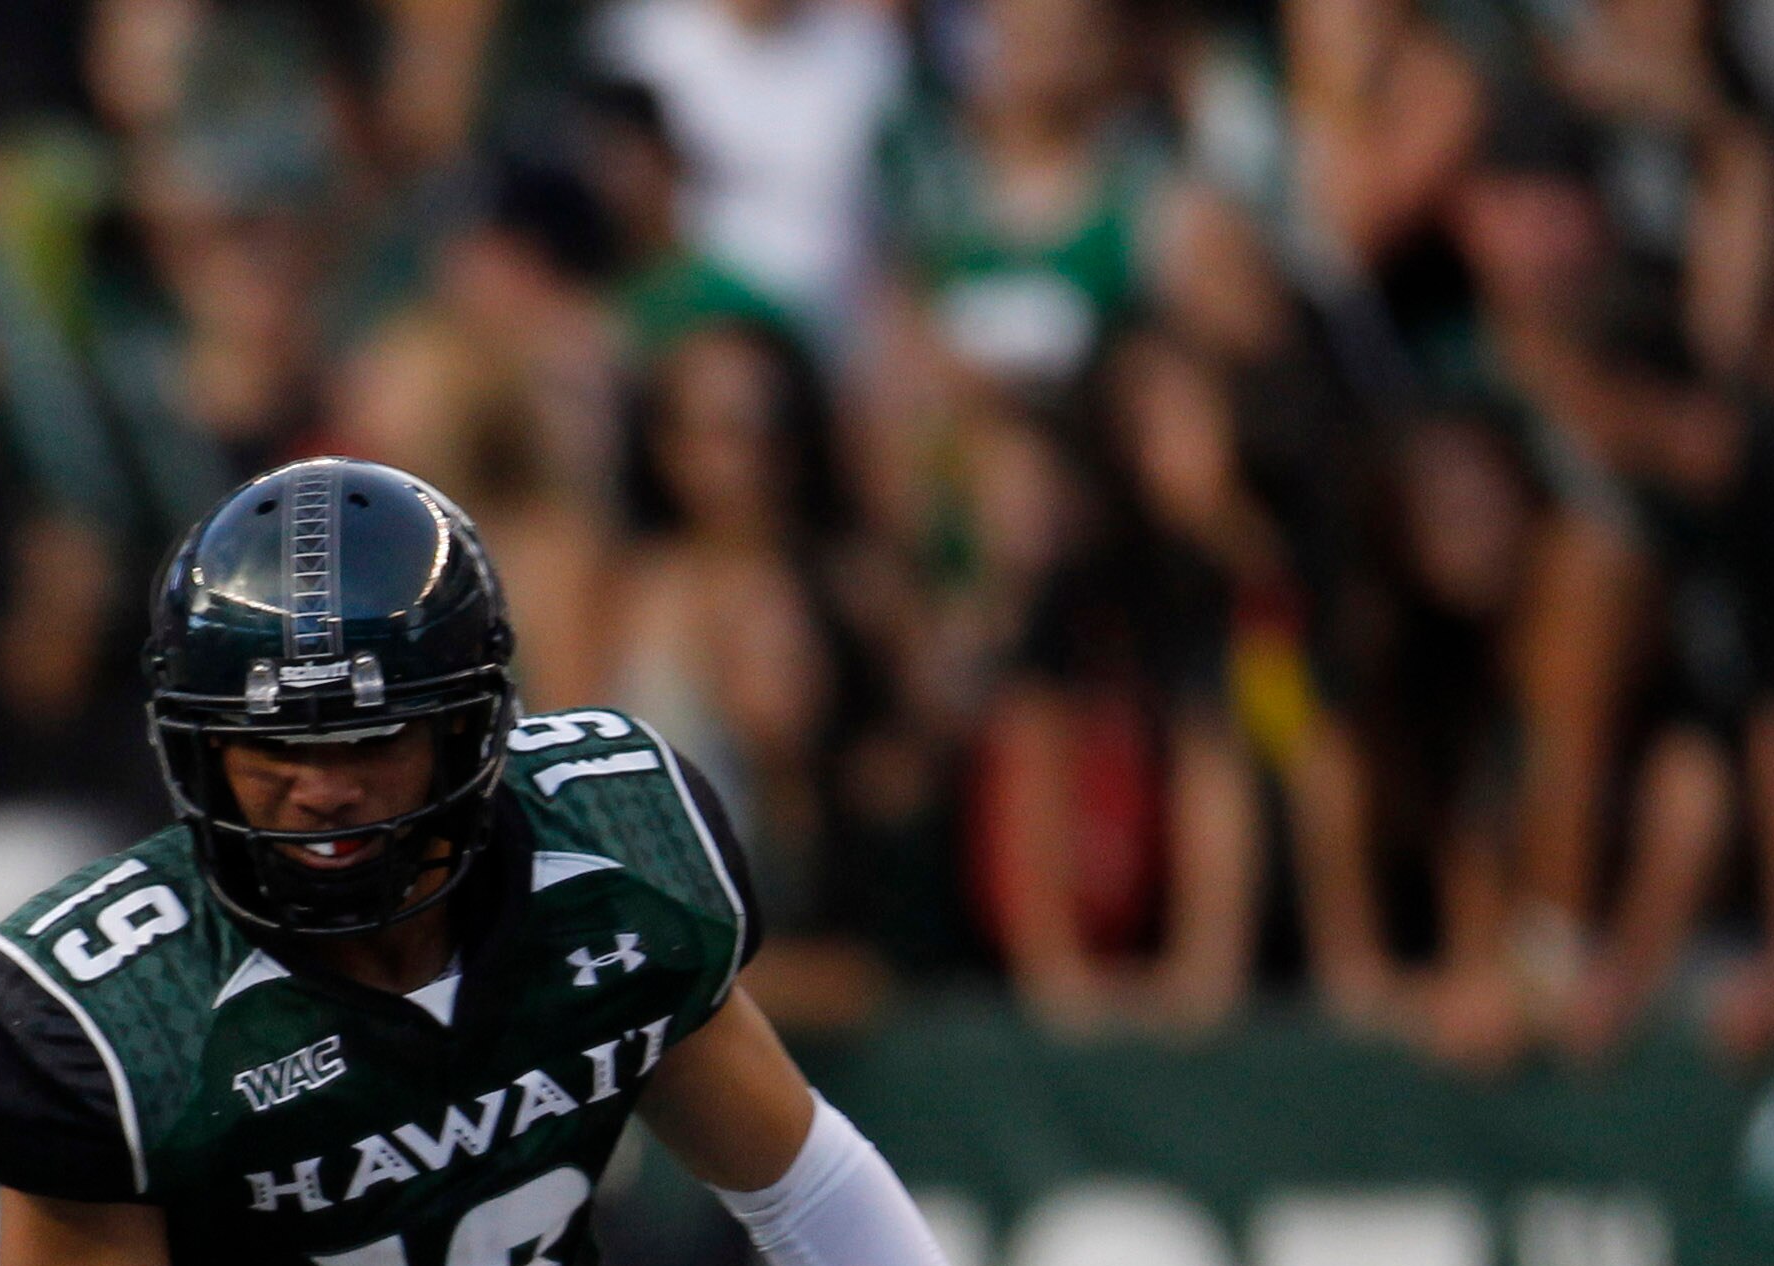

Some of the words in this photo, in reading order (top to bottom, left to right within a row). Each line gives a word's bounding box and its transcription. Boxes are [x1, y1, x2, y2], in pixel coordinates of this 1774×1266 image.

[506, 711, 659, 797] 19
[27, 859, 188, 981] 19
[232, 1034, 347, 1112] WAC
